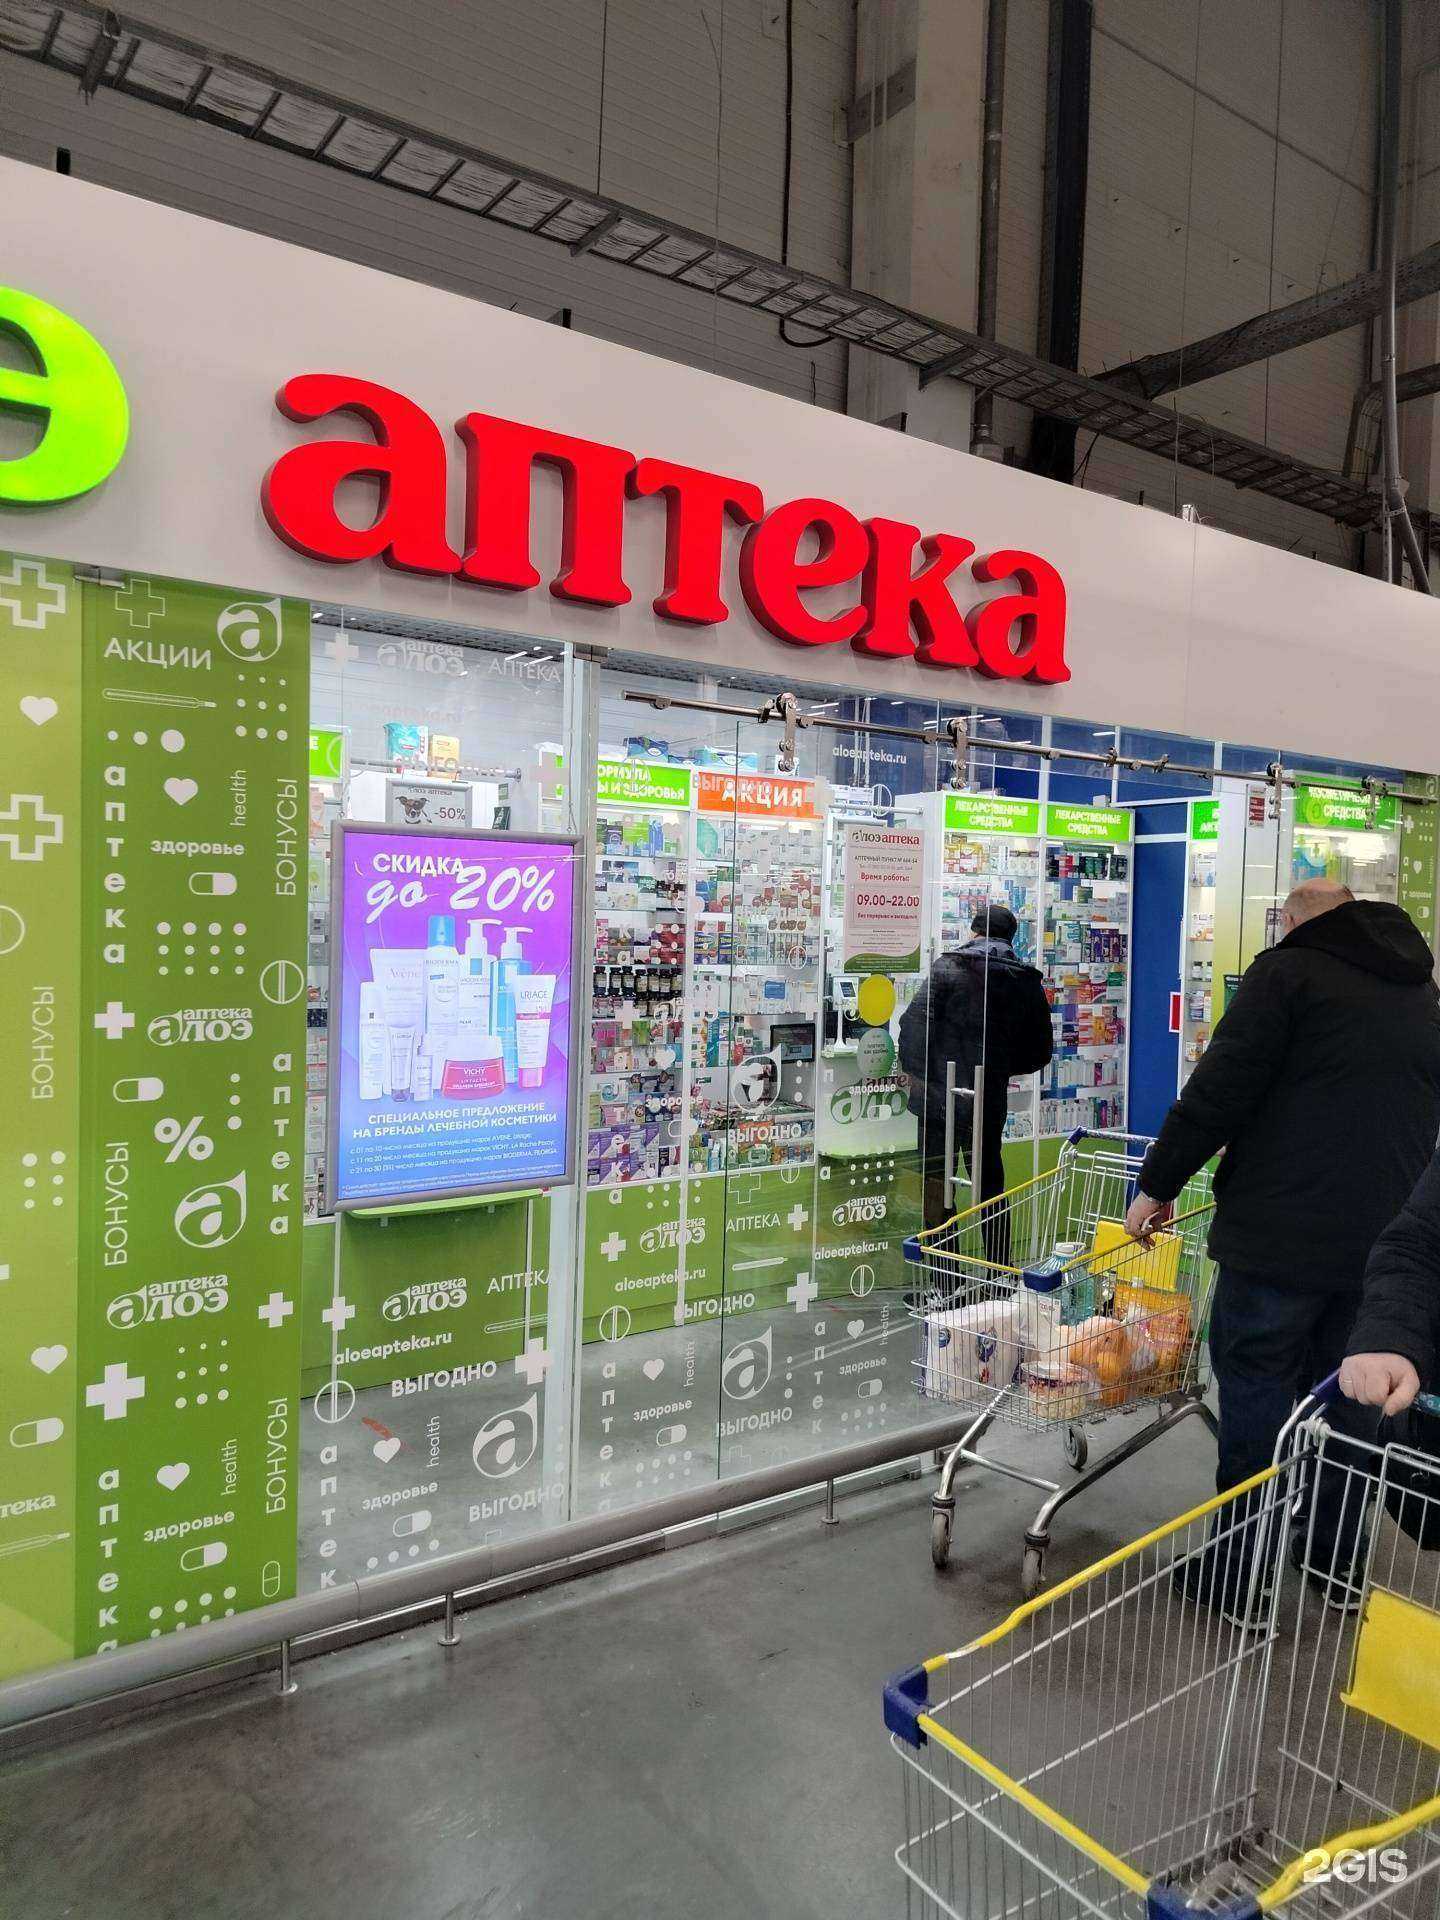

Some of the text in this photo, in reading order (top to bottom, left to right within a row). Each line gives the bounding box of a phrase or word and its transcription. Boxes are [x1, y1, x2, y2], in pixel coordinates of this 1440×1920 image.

[260, 373, 1072, 685] аптека
[103, 638, 212, 671] АКЦИИ
[488, 657, 561, 682] АПТЕКА
[832, 746, 907, 765] aloeapteka.ru
[229, 769, 247, 827] health
[721, 780, 802, 808] АКЦИЯ
[434, 807, 466, 820] -50%
[955, 799, 1029, 817] ЛЕКАРСТВЕННЫЕ
[1055, 810, 1122, 825] ЛЕКАРСТВЕННЫЕ
[1323, 804, 1367, 820] СРЕДСТВА
[969, 814, 1014, 829] СРЕДСТВА
[1067, 823, 1108, 836] СРЕДСТВА
[150, 839, 245, 857] здоровье
[276, 778, 299, 896] БОНУСЫ
[373, 854, 464, 877] СКИДКА
[861, 872, 882, 881] Время
[450, 865, 556, 913] 20%
[184, 1007, 253, 1020] аптека
[31, 986, 55, 1099] БОНУСЫ
[463, 1067, 486, 1076] VICHY
[849, 1083, 897, 1097] здоровье
[368, 1102, 545, 1125] СПЕЦИАЛЬНОЕ ПРЕДЛОЖЕНИЕ
[353, 1113, 557, 1138] НА БРЕНДЫ ЛЕЧЕБНОЙ КОСМЕТИКИ
[728, 1123, 802, 1145] ВЫГОДНО
[105, 1142, 129, 1266] БОНУСЫ
[850, 1195, 887, 1210] аптека
[660, 1216, 706, 1231] аптека
[725, 1213, 781, 1233] АПТЕКА
[815, 1241, 889, 1261] aloeapteka.ru
[148, 1275, 228, 1296] аптека
[411, 1277, 467, 1297] аптека
[615, 1267, 706, 1293] aloeapteka.ru
[335, 1330, 453, 1365] aloeapteka.ru
[683, 1341, 697, 1388] health
[839, 1356, 888, 1376] здоровье
[391, 1360, 498, 1398] ВЫГОДНО
[633, 1399, 693, 1423] здоровье
[716, 1406, 793, 1438] ВЫГОДНО
[426, 1415, 440, 1468] health
[221, 1438, 238, 1496] health
[266, 1397, 289, 1514] БОНУСЫ
[362, 1481, 438, 1512] здоровье
[469, 1483, 564, 1524] ВЫГОДНО
[144, 1510, 236, 1544] здоровье
